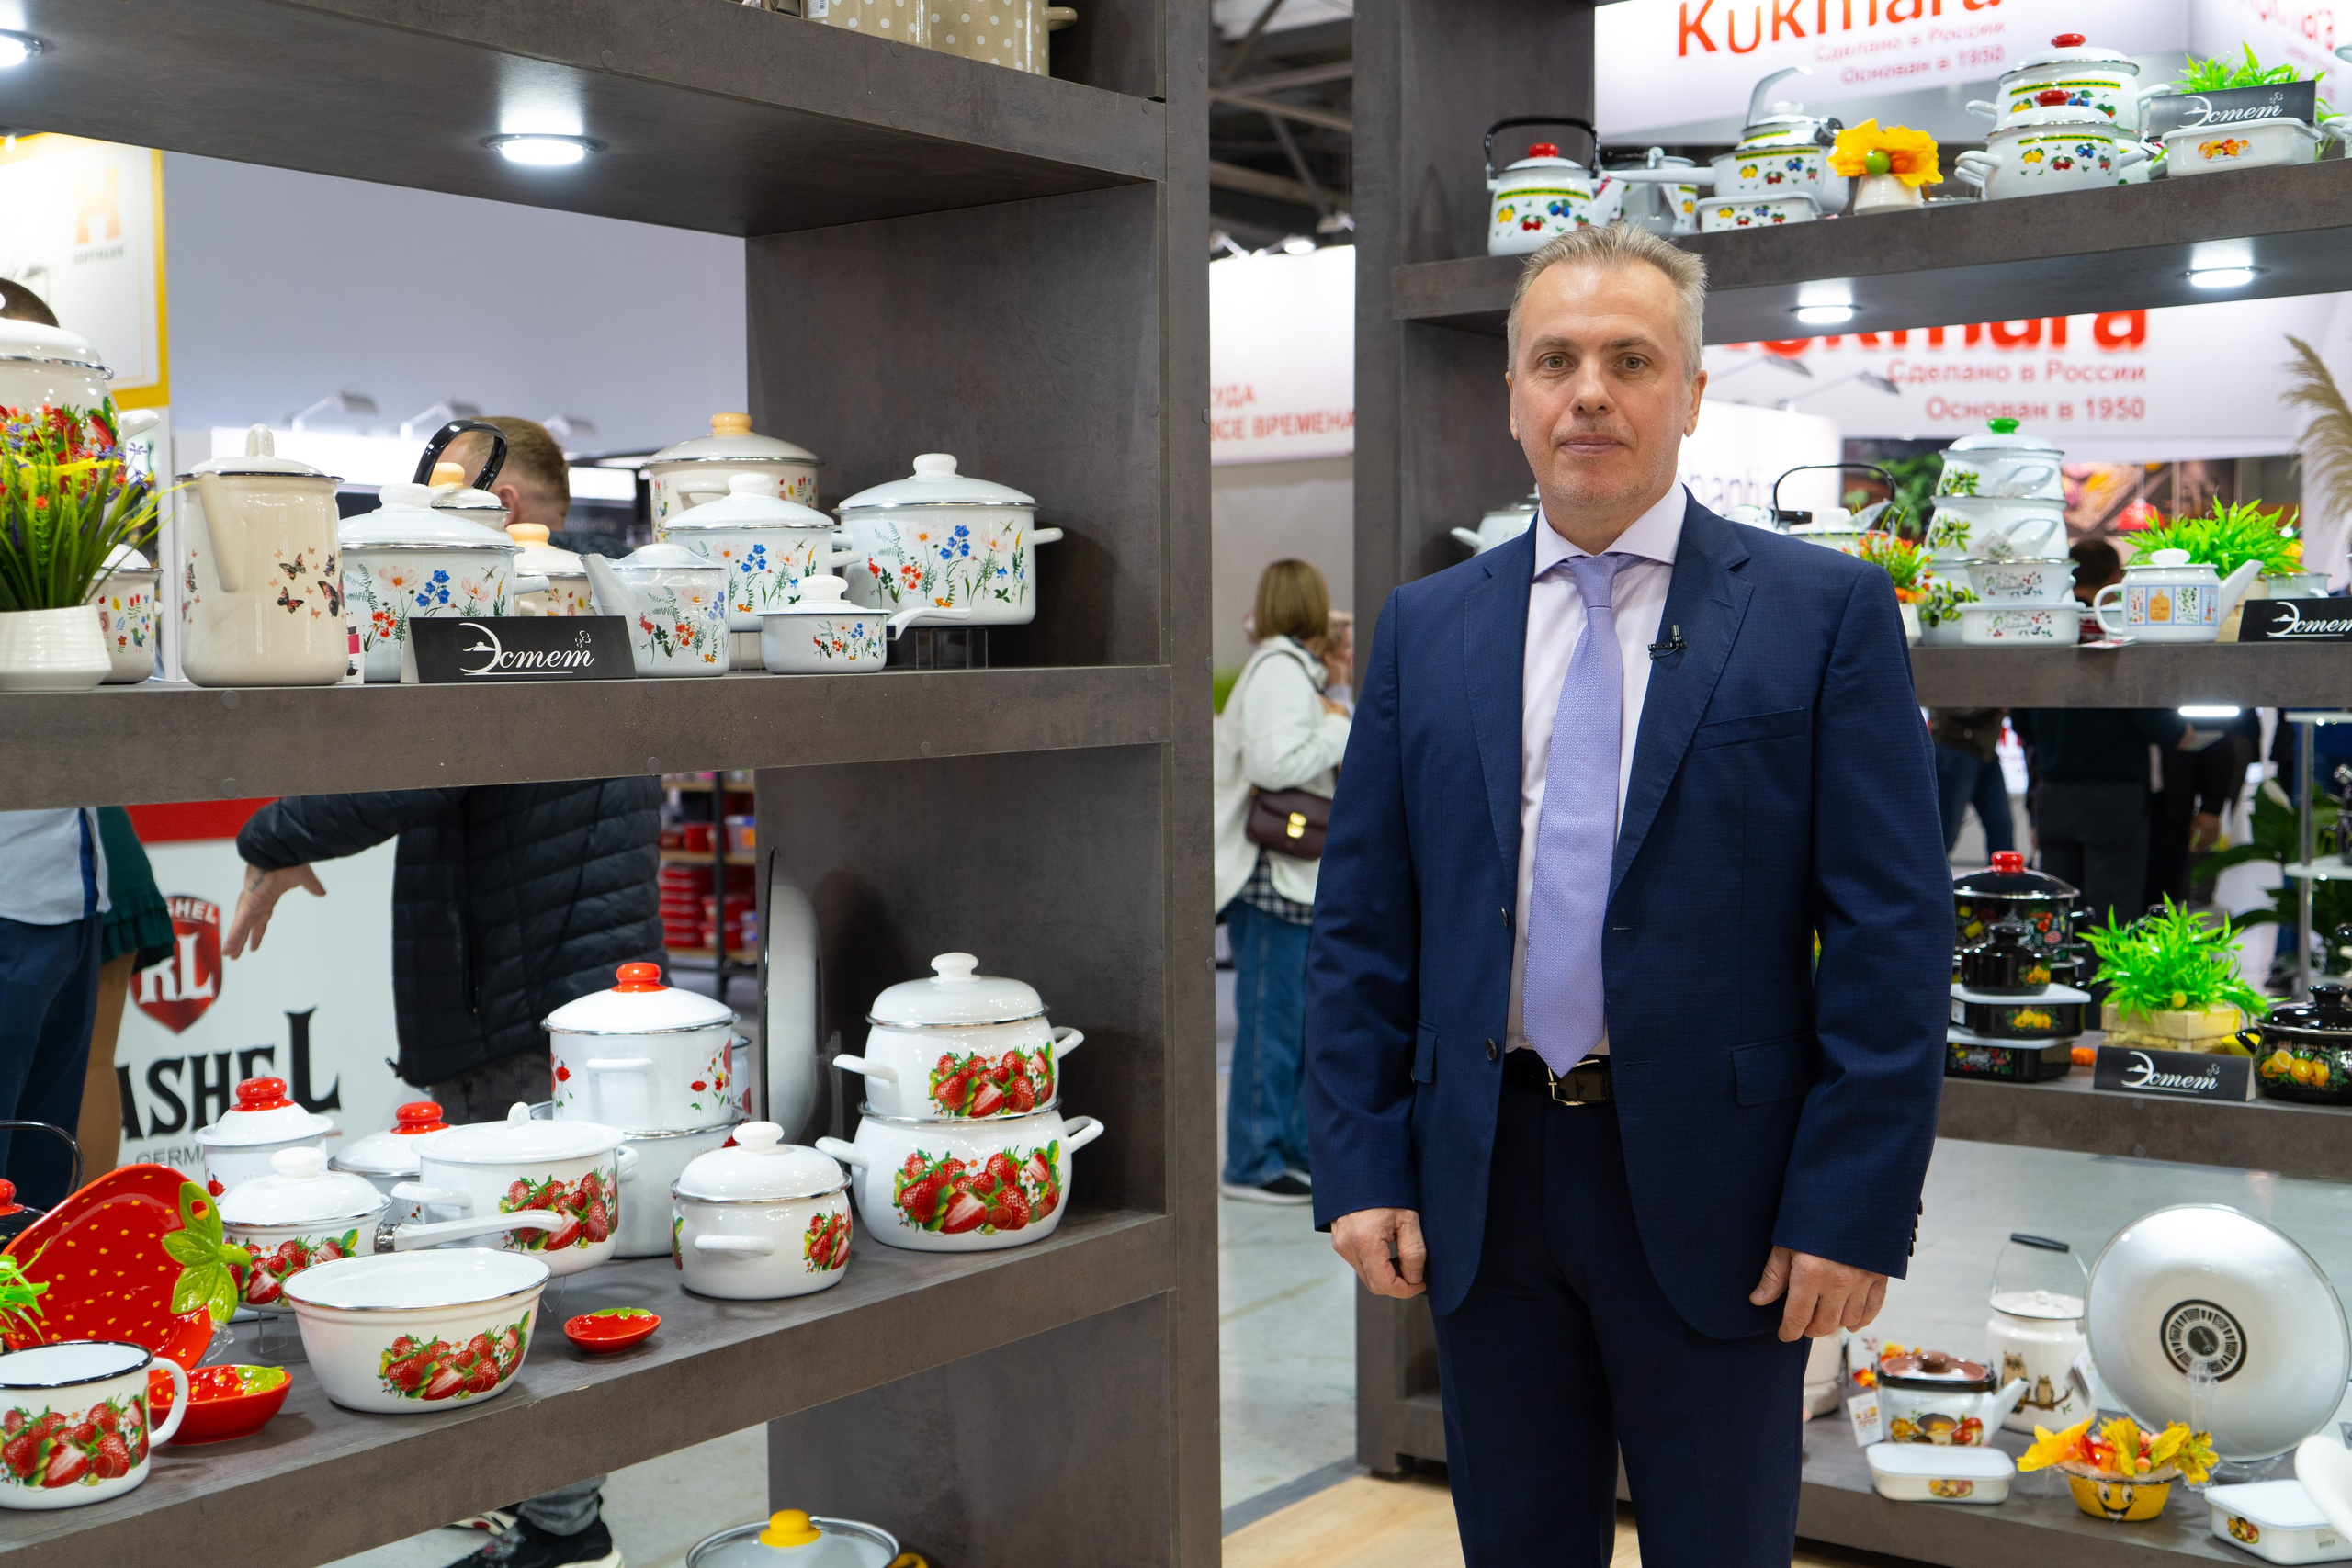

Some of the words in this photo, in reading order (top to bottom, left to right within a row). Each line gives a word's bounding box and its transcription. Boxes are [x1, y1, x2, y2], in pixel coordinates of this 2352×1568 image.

[1679, 0, 2001, 57] Kukma
[1841, 61, 1931, 85] Основан
[1938, 57, 1950, 70] в
[1959, 44, 2005, 67] 1950
[1887, 359, 2010, 385] Сделано
[2019, 366, 2036, 383] в
[2045, 359, 2146, 383] России
[1926, 396, 2048, 421] Основан
[2058, 402, 2074, 420] в
[2086, 396, 2146, 420] 1950
[458, 622, 595, 675] Эстет
[2120, 1050, 2219, 1092] Эстет
